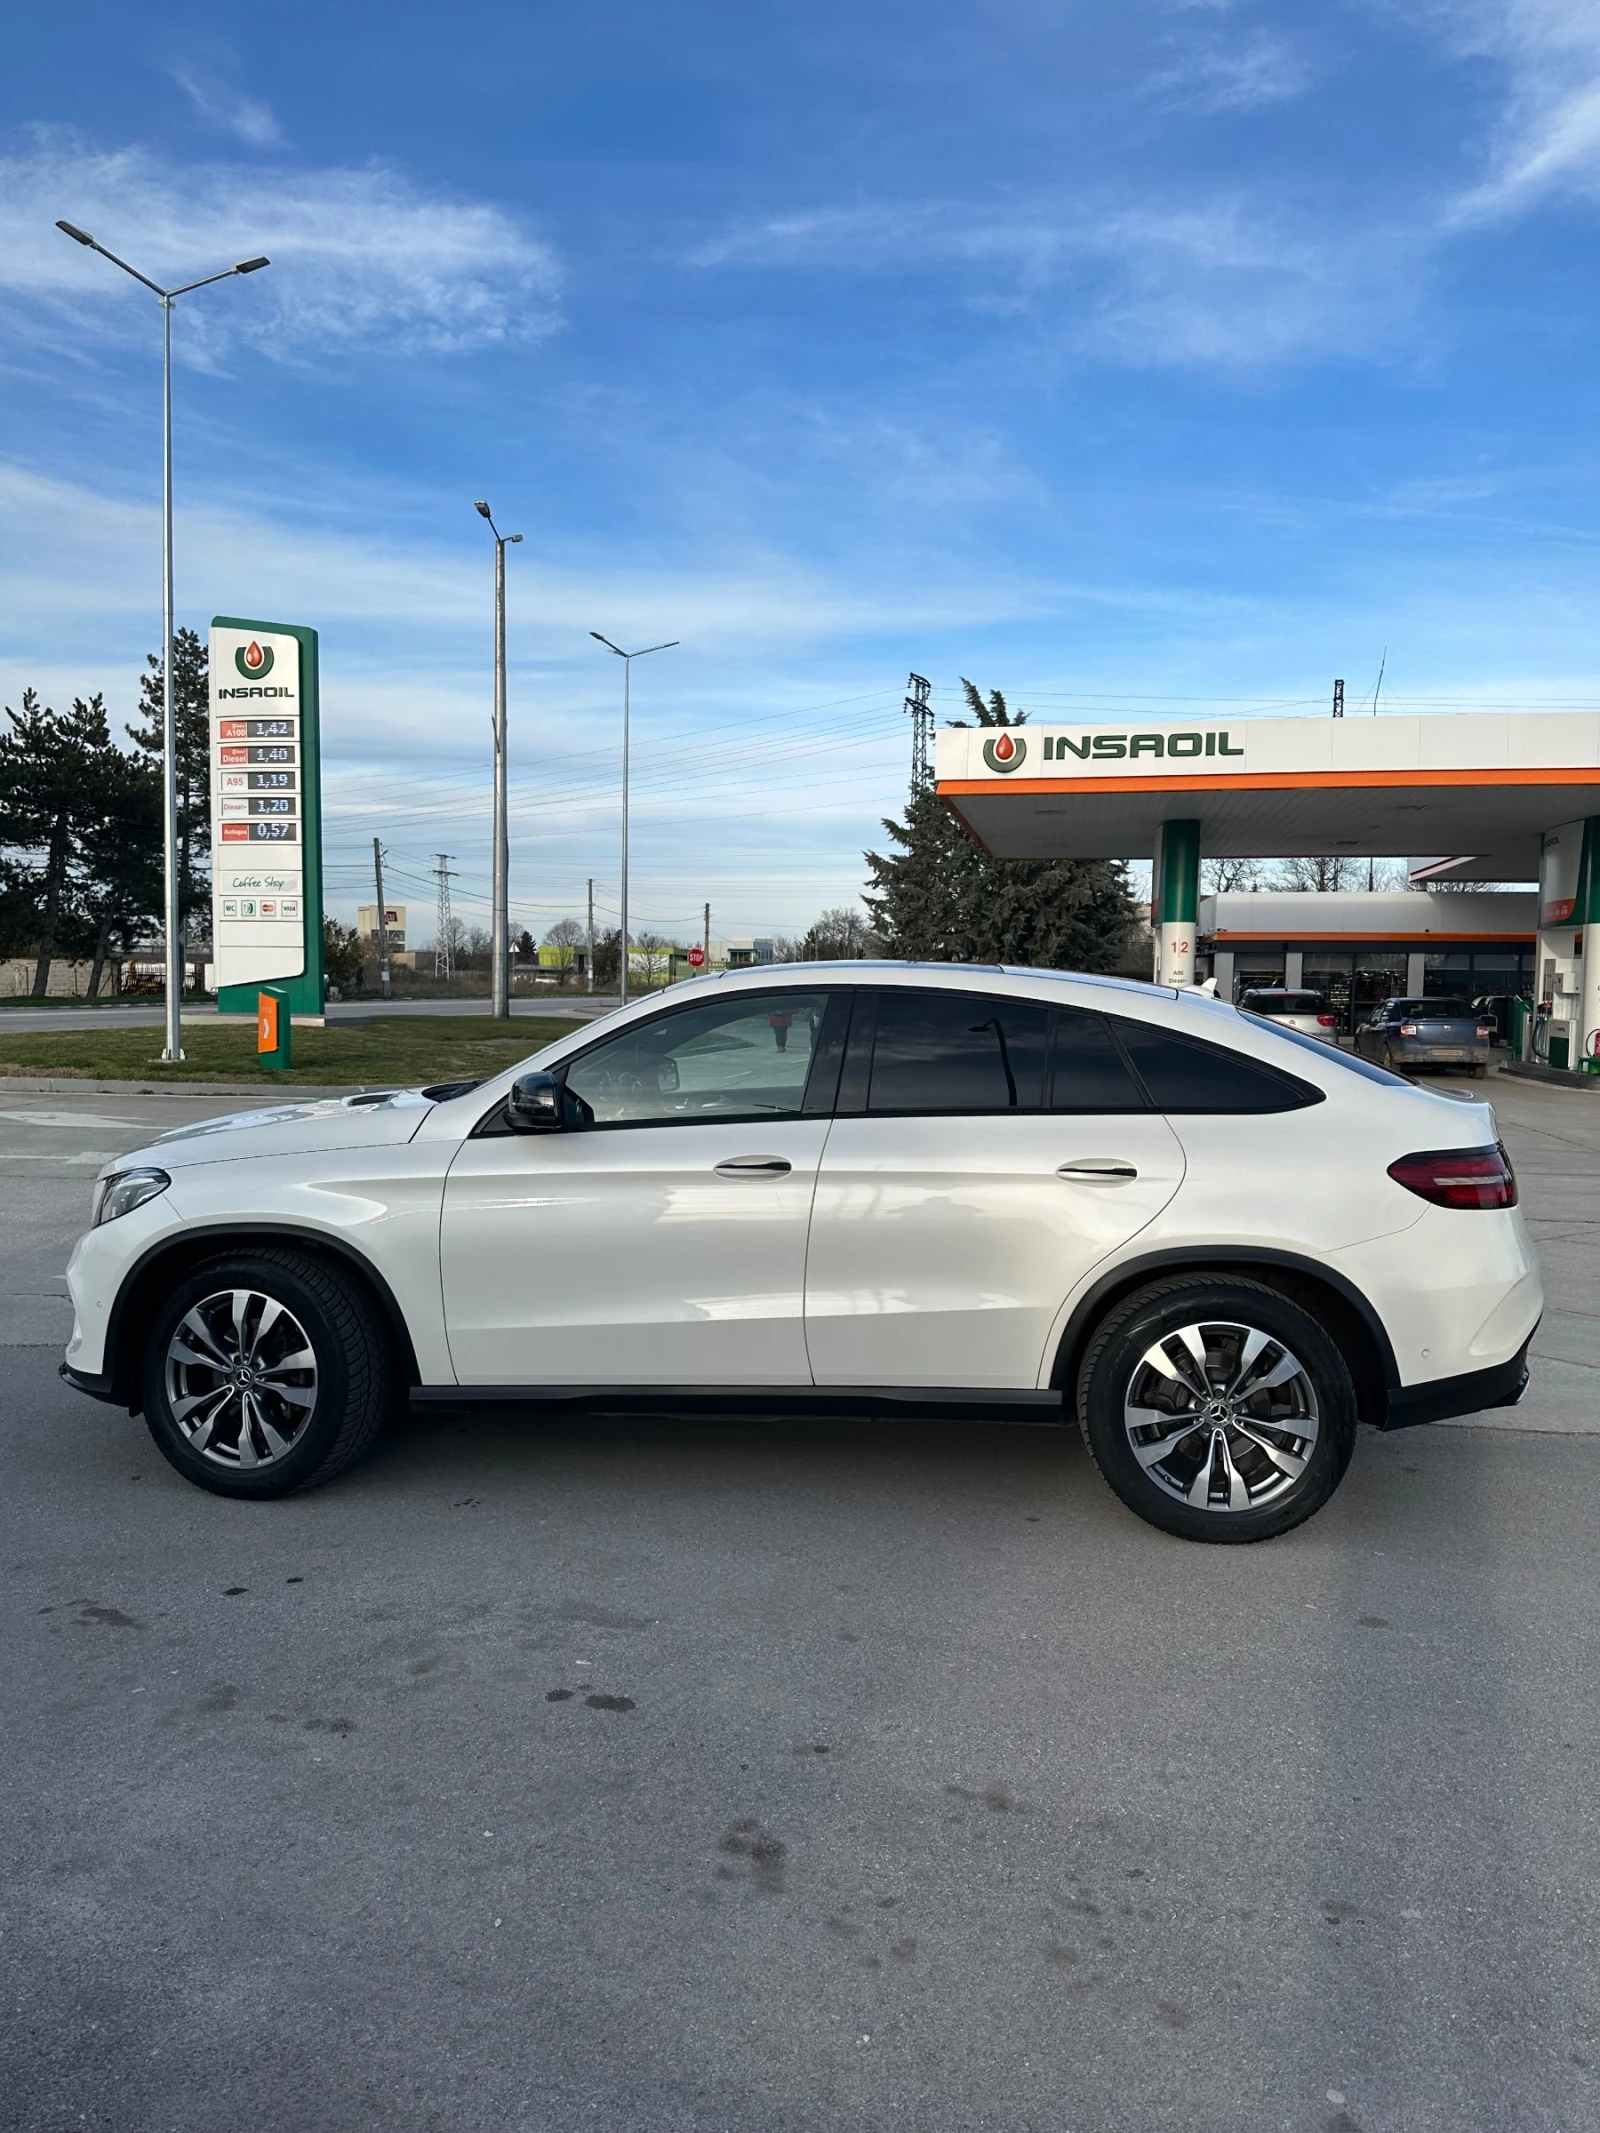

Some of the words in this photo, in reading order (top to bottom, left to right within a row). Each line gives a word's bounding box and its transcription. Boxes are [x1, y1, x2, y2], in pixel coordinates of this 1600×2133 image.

[218, 687, 295, 700] INSAOIL
[226, 729, 246, 737] A100
[256, 722, 288, 737] 1,42
[1043, 731, 1245, 761] INSAOIL
[222, 754, 246, 763] Diesel
[256, 748, 288, 763] 1,40
[226, 777, 244, 786] A95
[257, 774, 288, 788] 1,19
[257, 799, 289, 813] 1,20
[257, 823, 289, 839] 0,57
[232, 876, 262, 888] Coffee
[264, 876, 285, 891] Shop
[225, 904, 236, 913] WC
[689, 953, 704, 962] STOP
